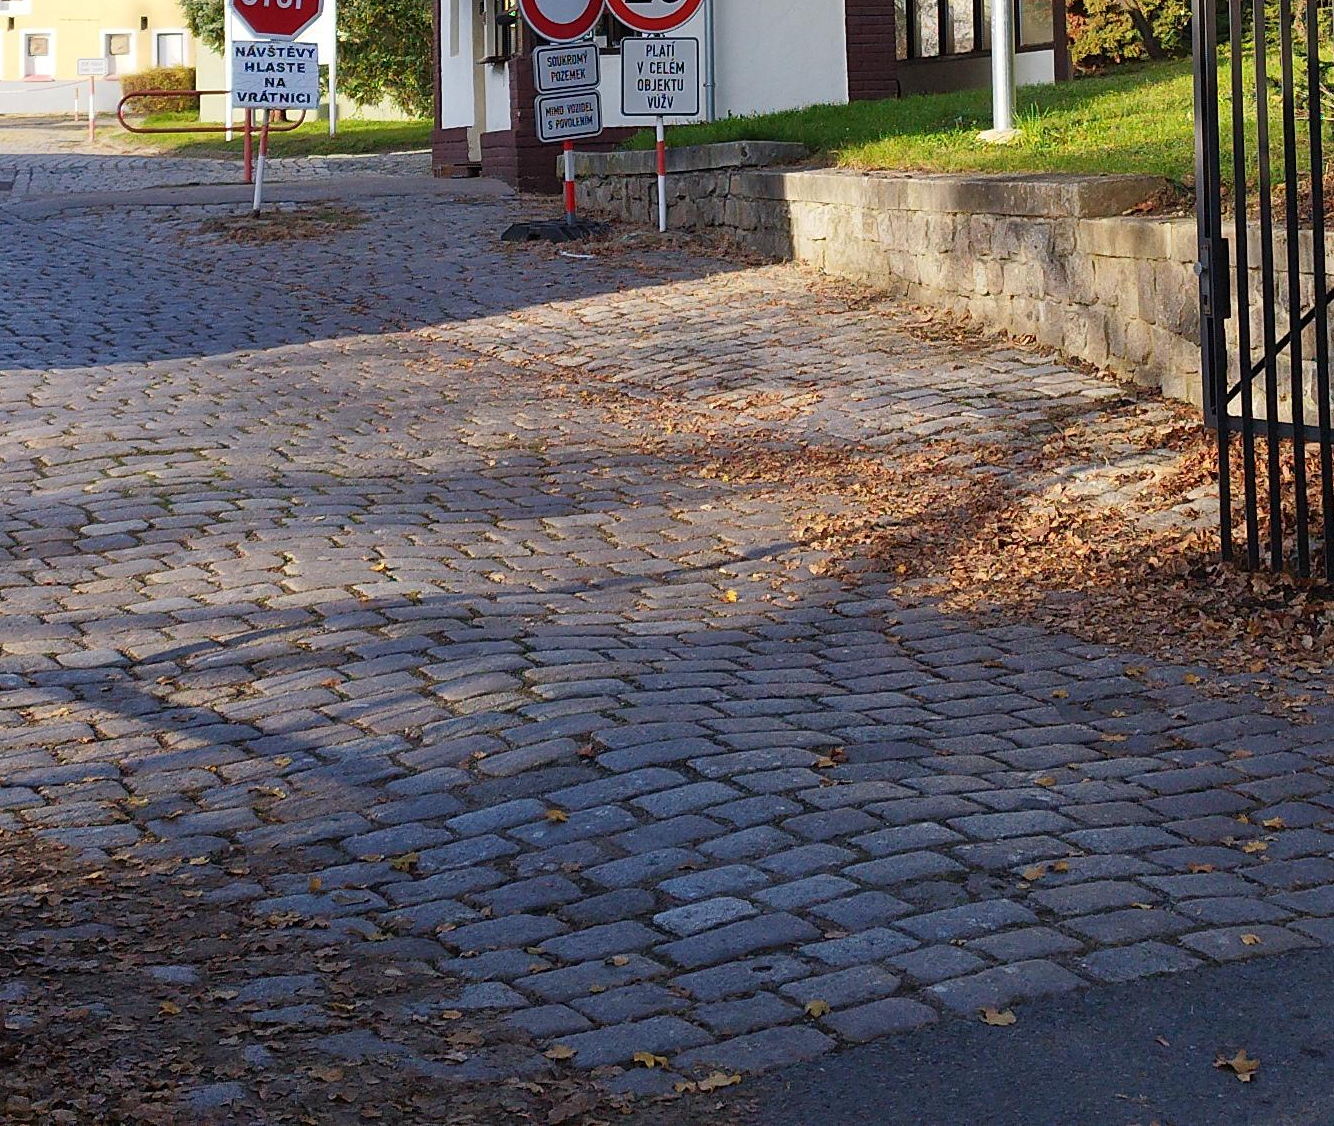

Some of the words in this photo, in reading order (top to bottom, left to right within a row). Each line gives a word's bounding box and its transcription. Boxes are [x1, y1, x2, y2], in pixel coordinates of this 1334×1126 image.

[235, 44, 316, 59] NÁVŠTĚVY
[646, 41, 676, 57] PLATÍ
[547, 50, 588, 67] SOUKROMÝ
[637, 61, 644, 74] V
[649, 58, 685, 74] CELÉM
[245, 62, 306, 73] HLASTE
[551, 68, 586, 82] POZEMEK
[264, 77, 286, 88] NA
[637, 79, 684, 92] OBJEKTU
[237, 90, 311, 104] VRÁTNICI
[647, 93, 674, 109] VÚŽV
[545, 105, 564, 117] MIMO
[567, 102, 594, 114] VOZIDEL
[548, 120, 553, 130] S
[555, 115, 593, 130] POVOLENÍM
